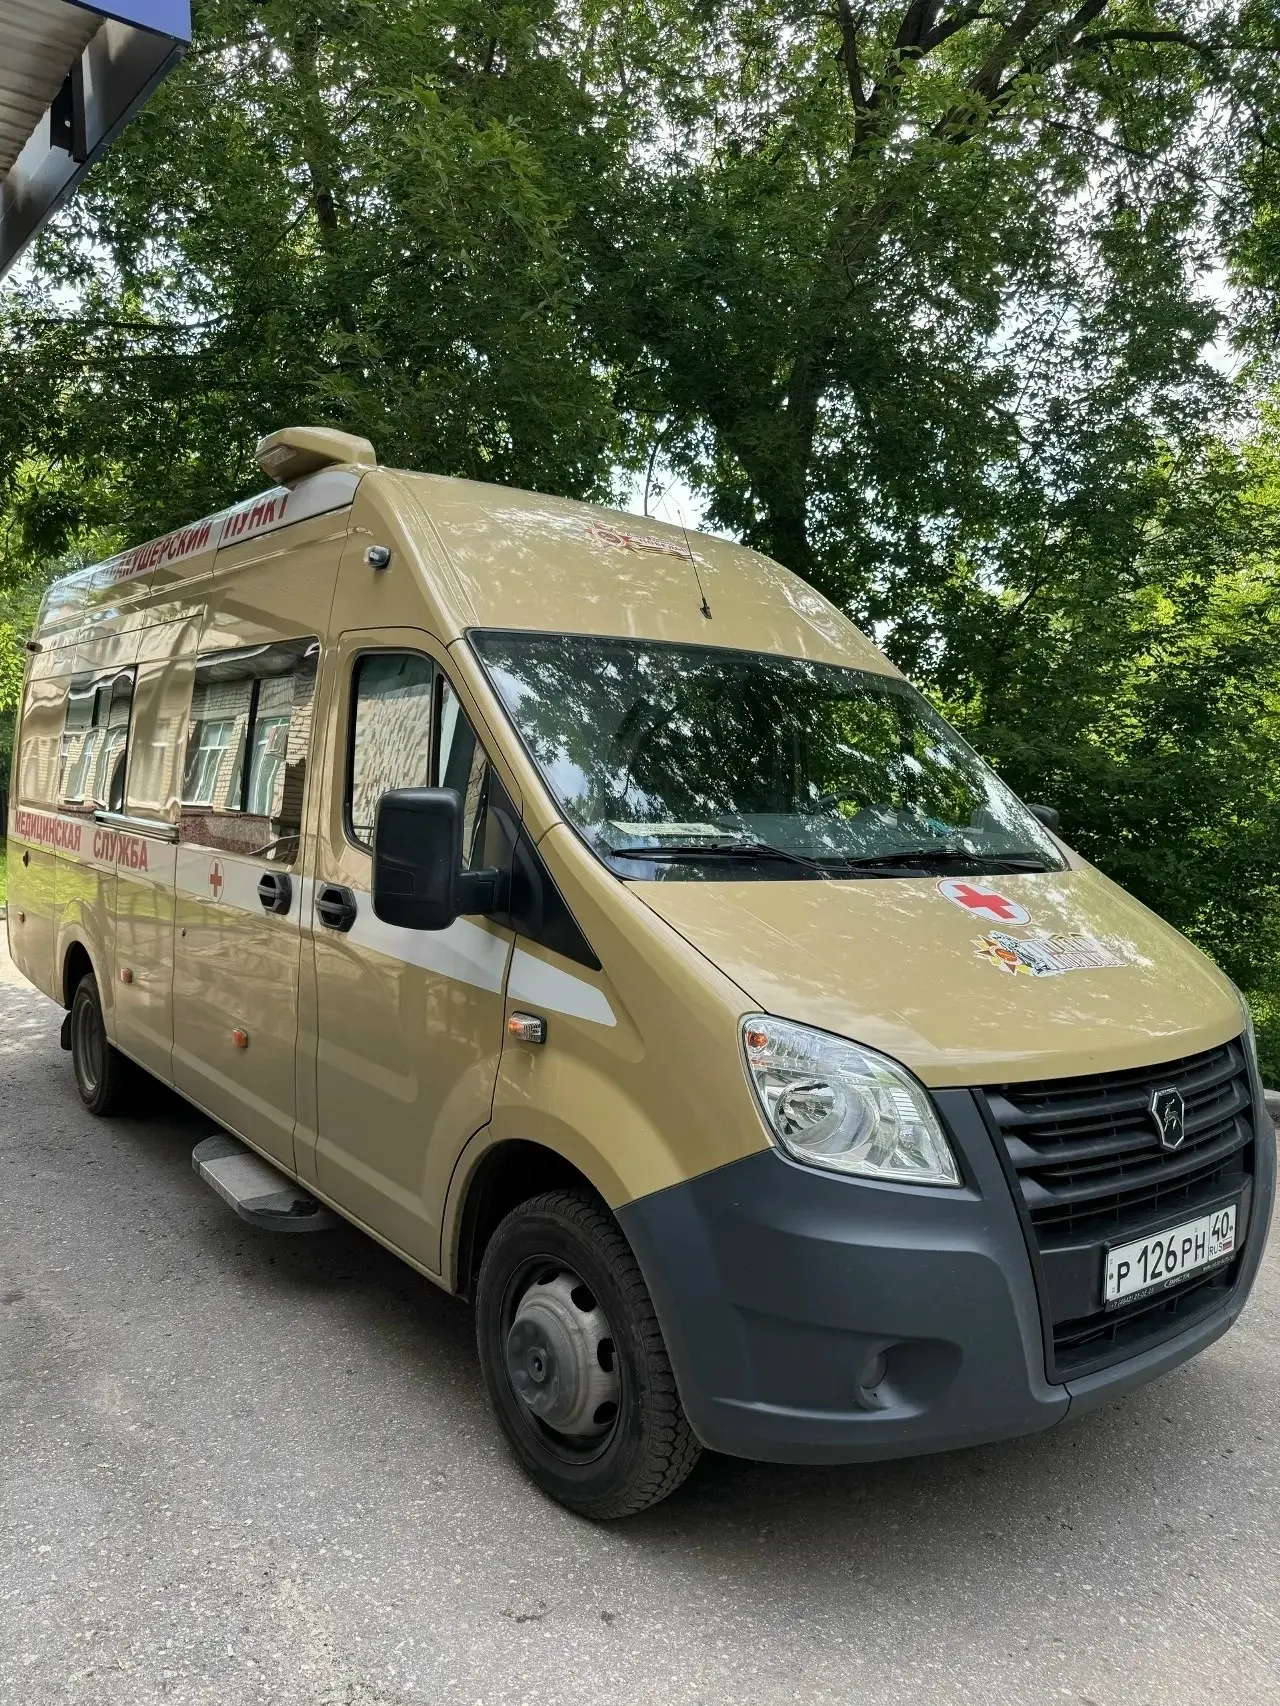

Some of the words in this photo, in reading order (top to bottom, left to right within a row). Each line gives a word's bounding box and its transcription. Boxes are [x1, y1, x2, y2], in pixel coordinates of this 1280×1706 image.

[15, 811, 82, 852] МЕДИЦИНСКАЯ
[93, 830, 148, 871] СЛУЖБА
[1211, 1212, 1229, 1241] 40
[1209, 1245, 1222, 1255] RUS
